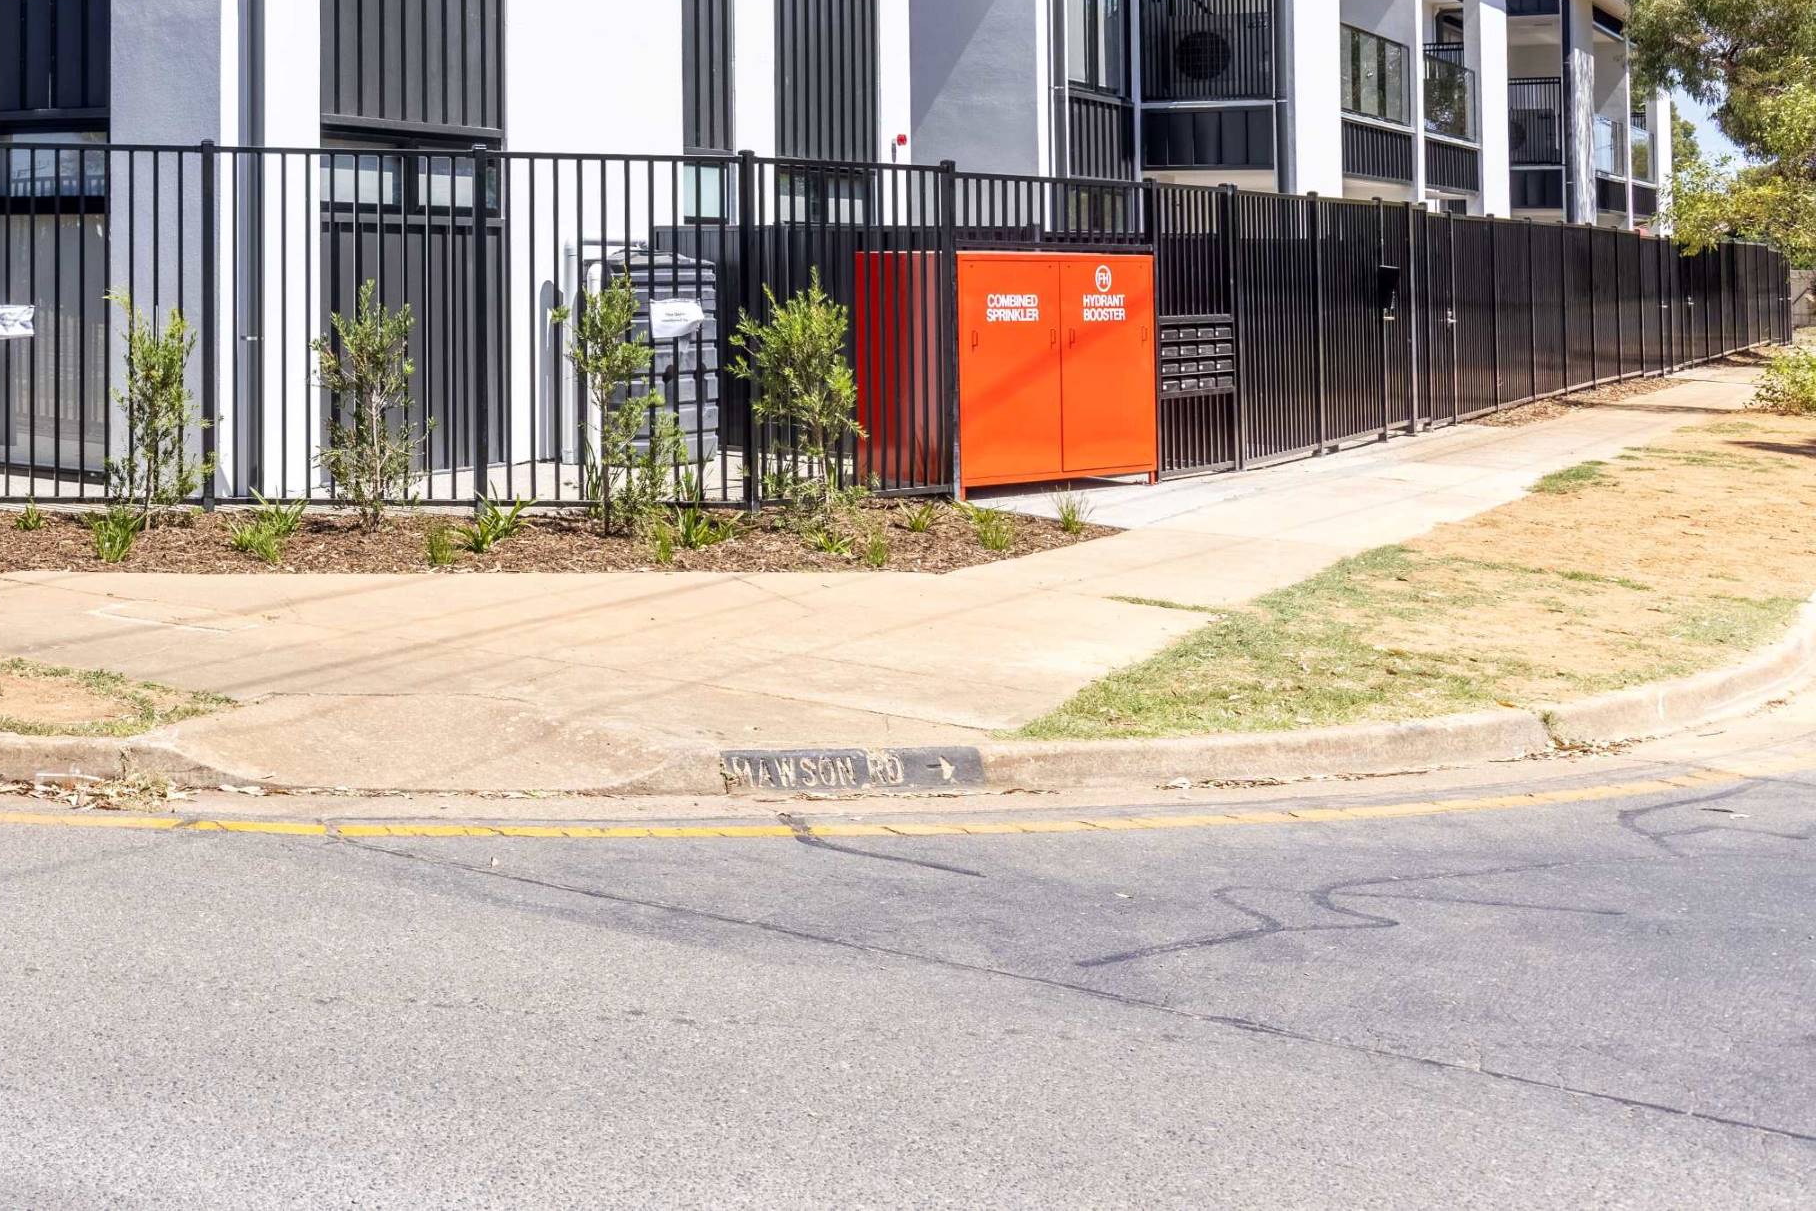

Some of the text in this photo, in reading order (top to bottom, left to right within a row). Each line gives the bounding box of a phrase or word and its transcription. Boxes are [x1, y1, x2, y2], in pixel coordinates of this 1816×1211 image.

[1098, 273, 1109, 285] FH
[987, 294, 1039, 307] COMBINED
[1083, 294, 1125, 307] HYDRANT
[986, 308, 1040, 322] SPRINKLER
[1083, 308, 1126, 322] BOOSTER
[732, 752, 905, 788] MAWSON RD
